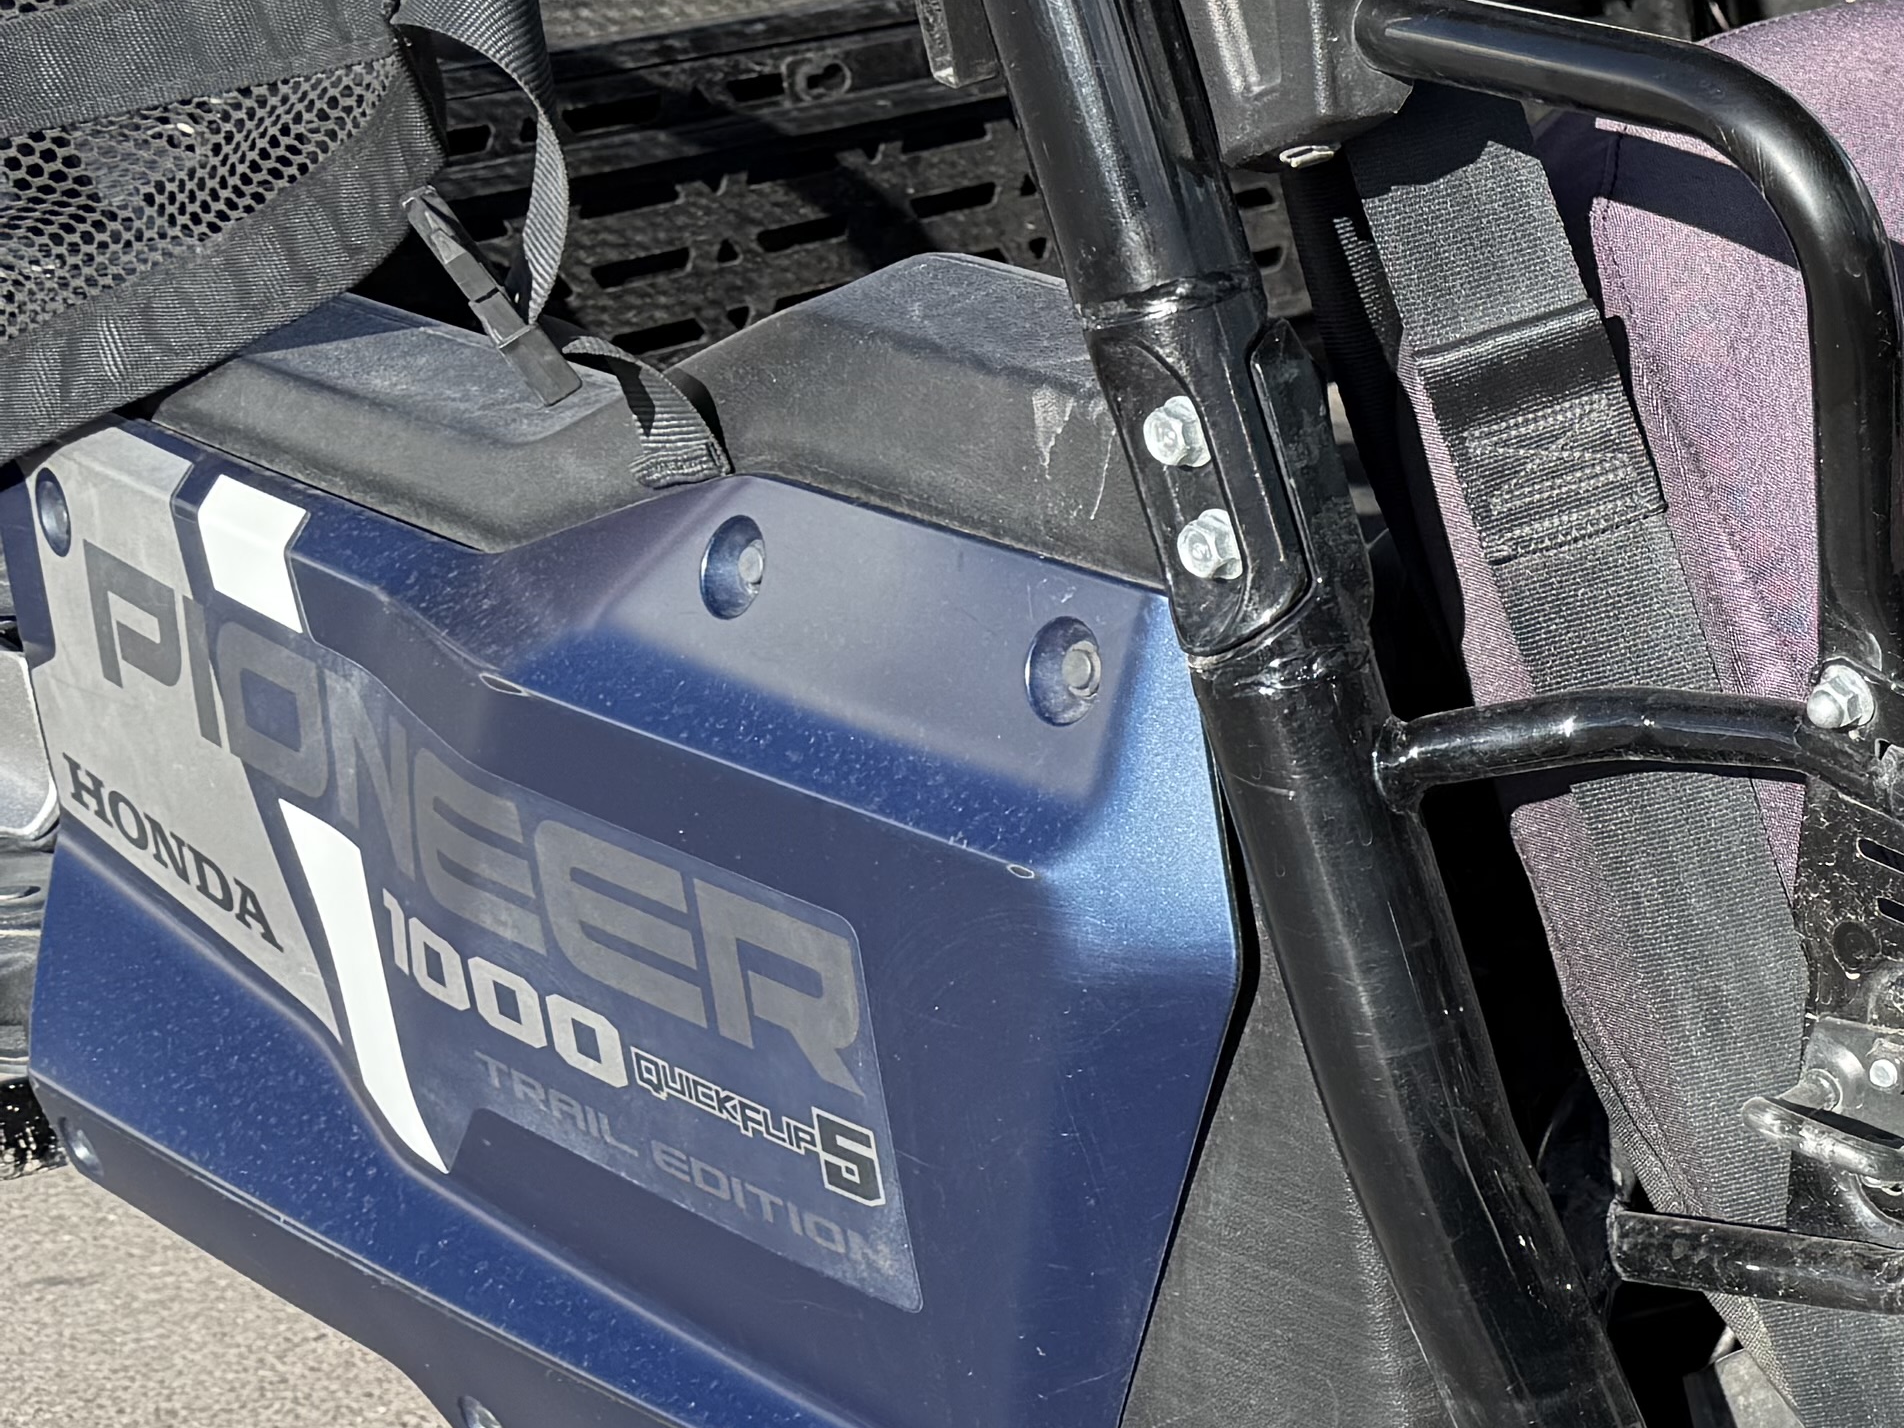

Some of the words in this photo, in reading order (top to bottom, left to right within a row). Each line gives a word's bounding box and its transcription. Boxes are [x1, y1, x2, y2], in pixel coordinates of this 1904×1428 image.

[62, 752, 284, 953] HONDA
[83, 539, 866, 1098] PIONEER
[383, 887, 629, 1088] 1000
[474, 1050, 638, 1158] TRAIL
[650, 1139, 893, 1269] EDITION
